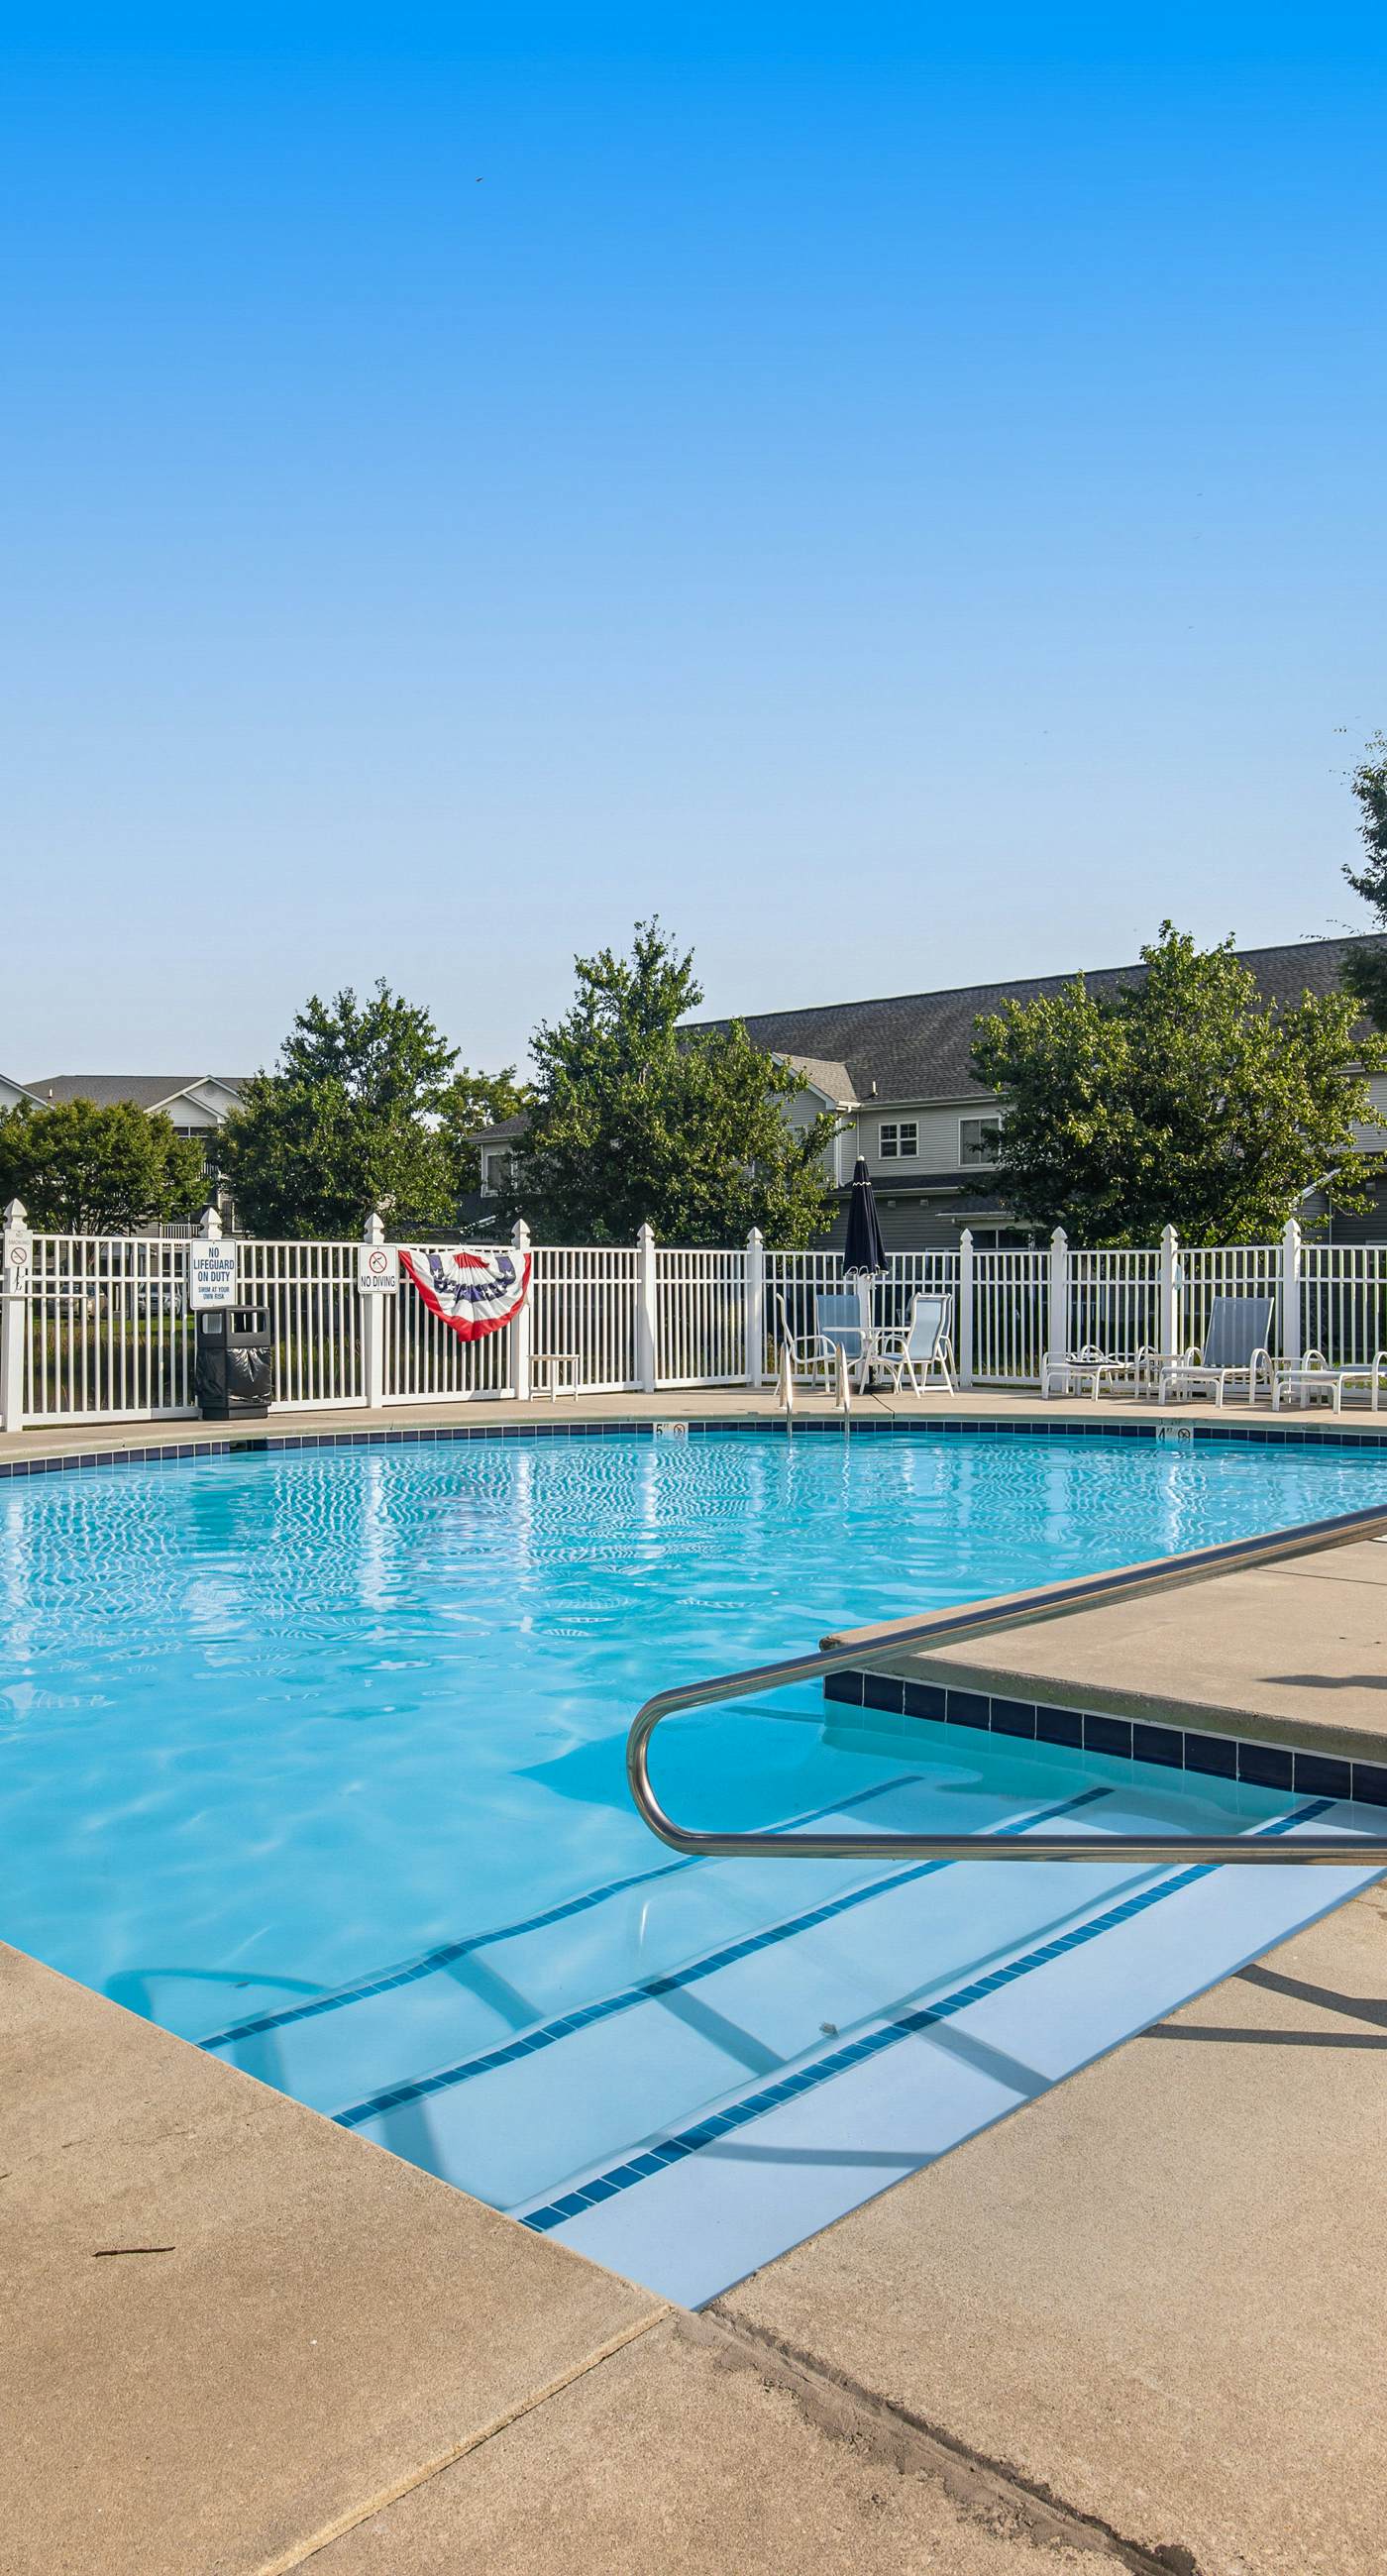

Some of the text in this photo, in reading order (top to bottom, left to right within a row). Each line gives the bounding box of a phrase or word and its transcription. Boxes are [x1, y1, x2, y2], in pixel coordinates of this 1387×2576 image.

[209, 1247, 219, 1258] NO
[194, 1259, 234, 1270] LIFEGUARD
[198, 1271, 230, 1282] ON DUTY
[361, 1276, 395, 1287] NO DIVING
[656, 1423, 663, 1435] 5
